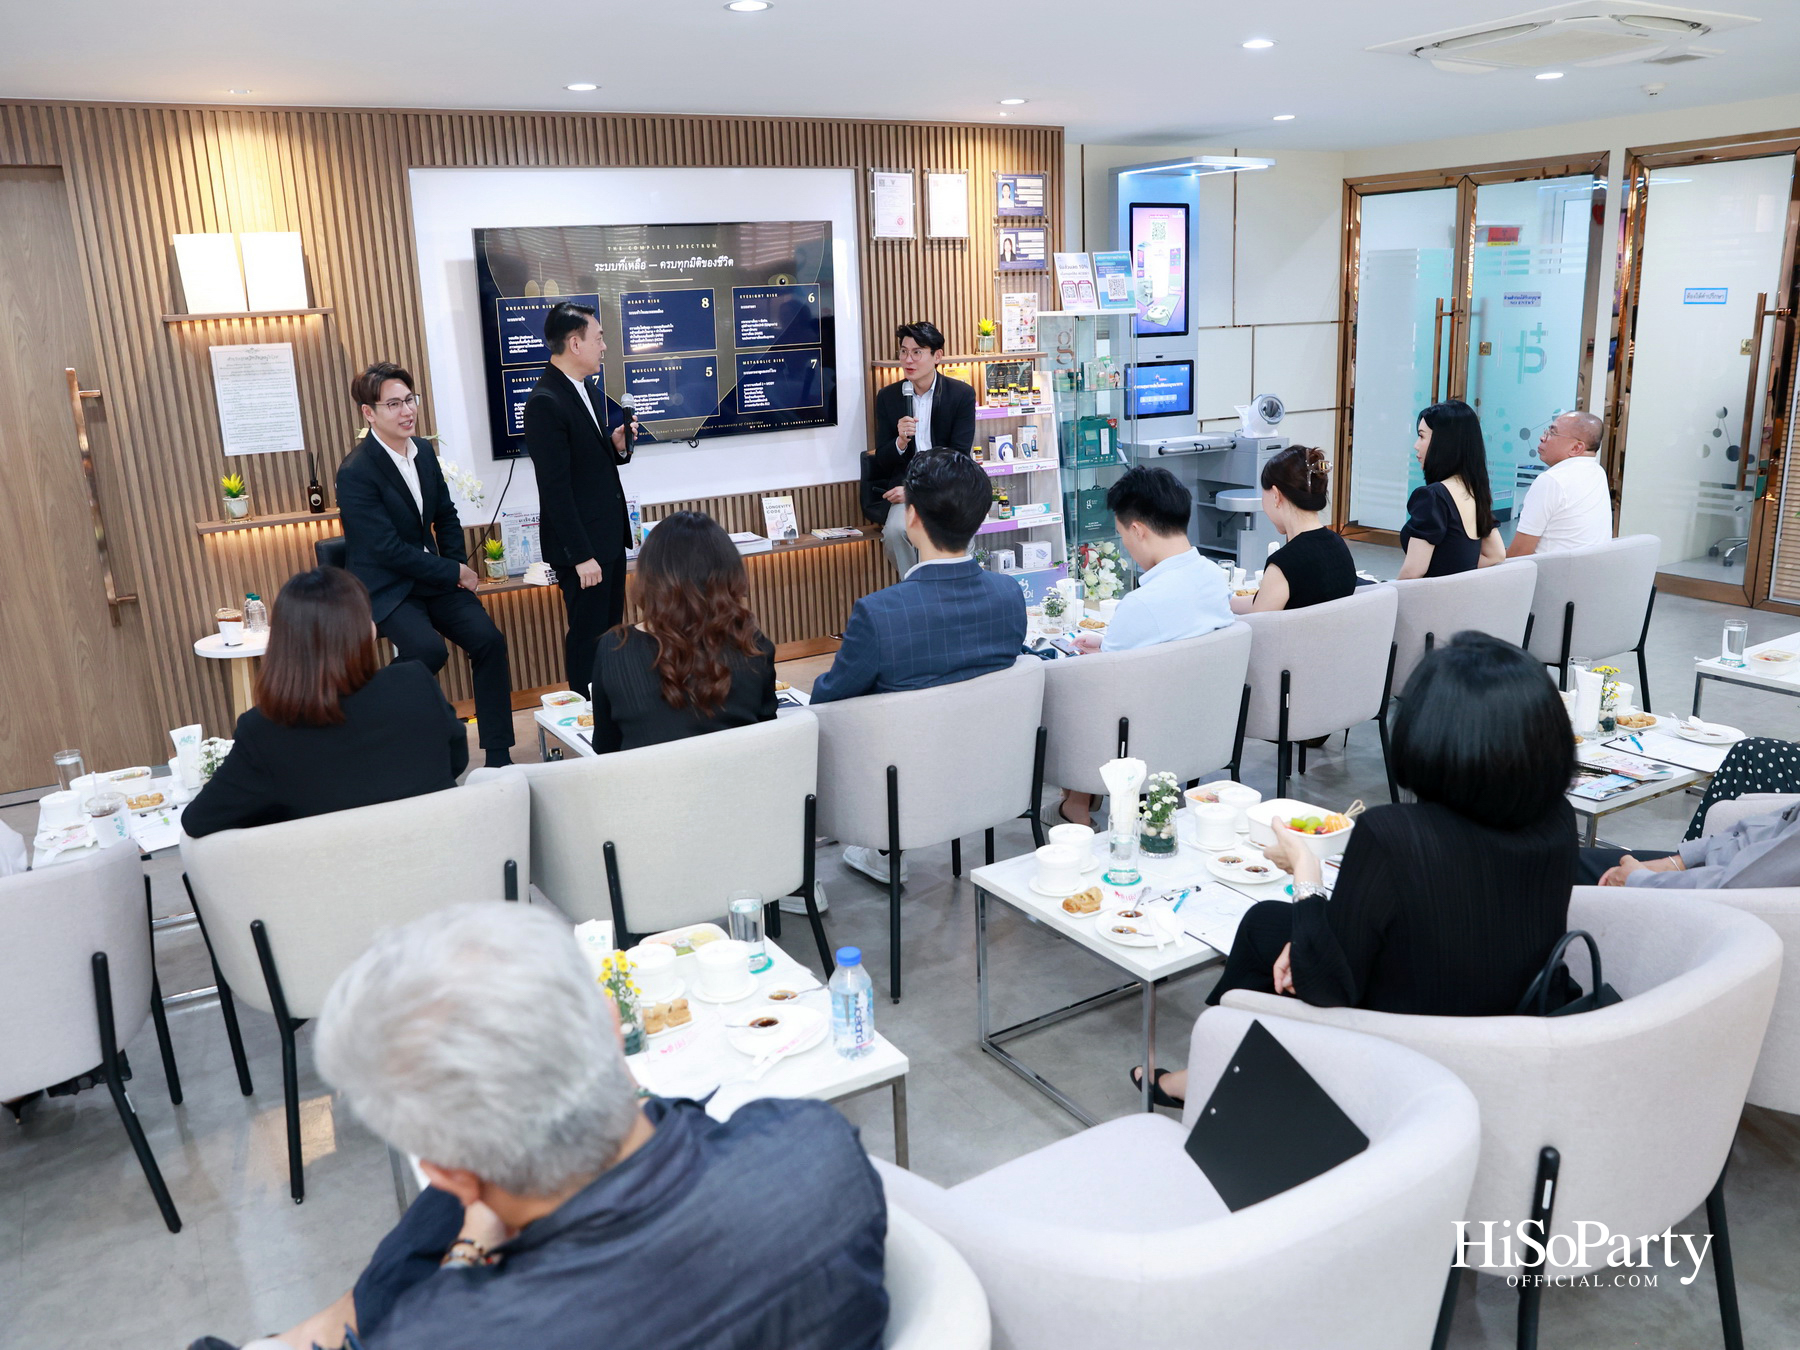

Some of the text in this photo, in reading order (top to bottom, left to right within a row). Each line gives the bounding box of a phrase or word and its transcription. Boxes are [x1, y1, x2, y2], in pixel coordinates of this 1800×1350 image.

[660, 255, 734, 272] ครบทุกมิติของชีวิต
[701, 297, 710, 308] 8
[808, 292, 815, 303] 6
[810, 359, 817, 369] 7
[705, 367, 713, 377] 5
[592, 375, 600, 386] 7
[854, 1006, 865, 1044] iceland
